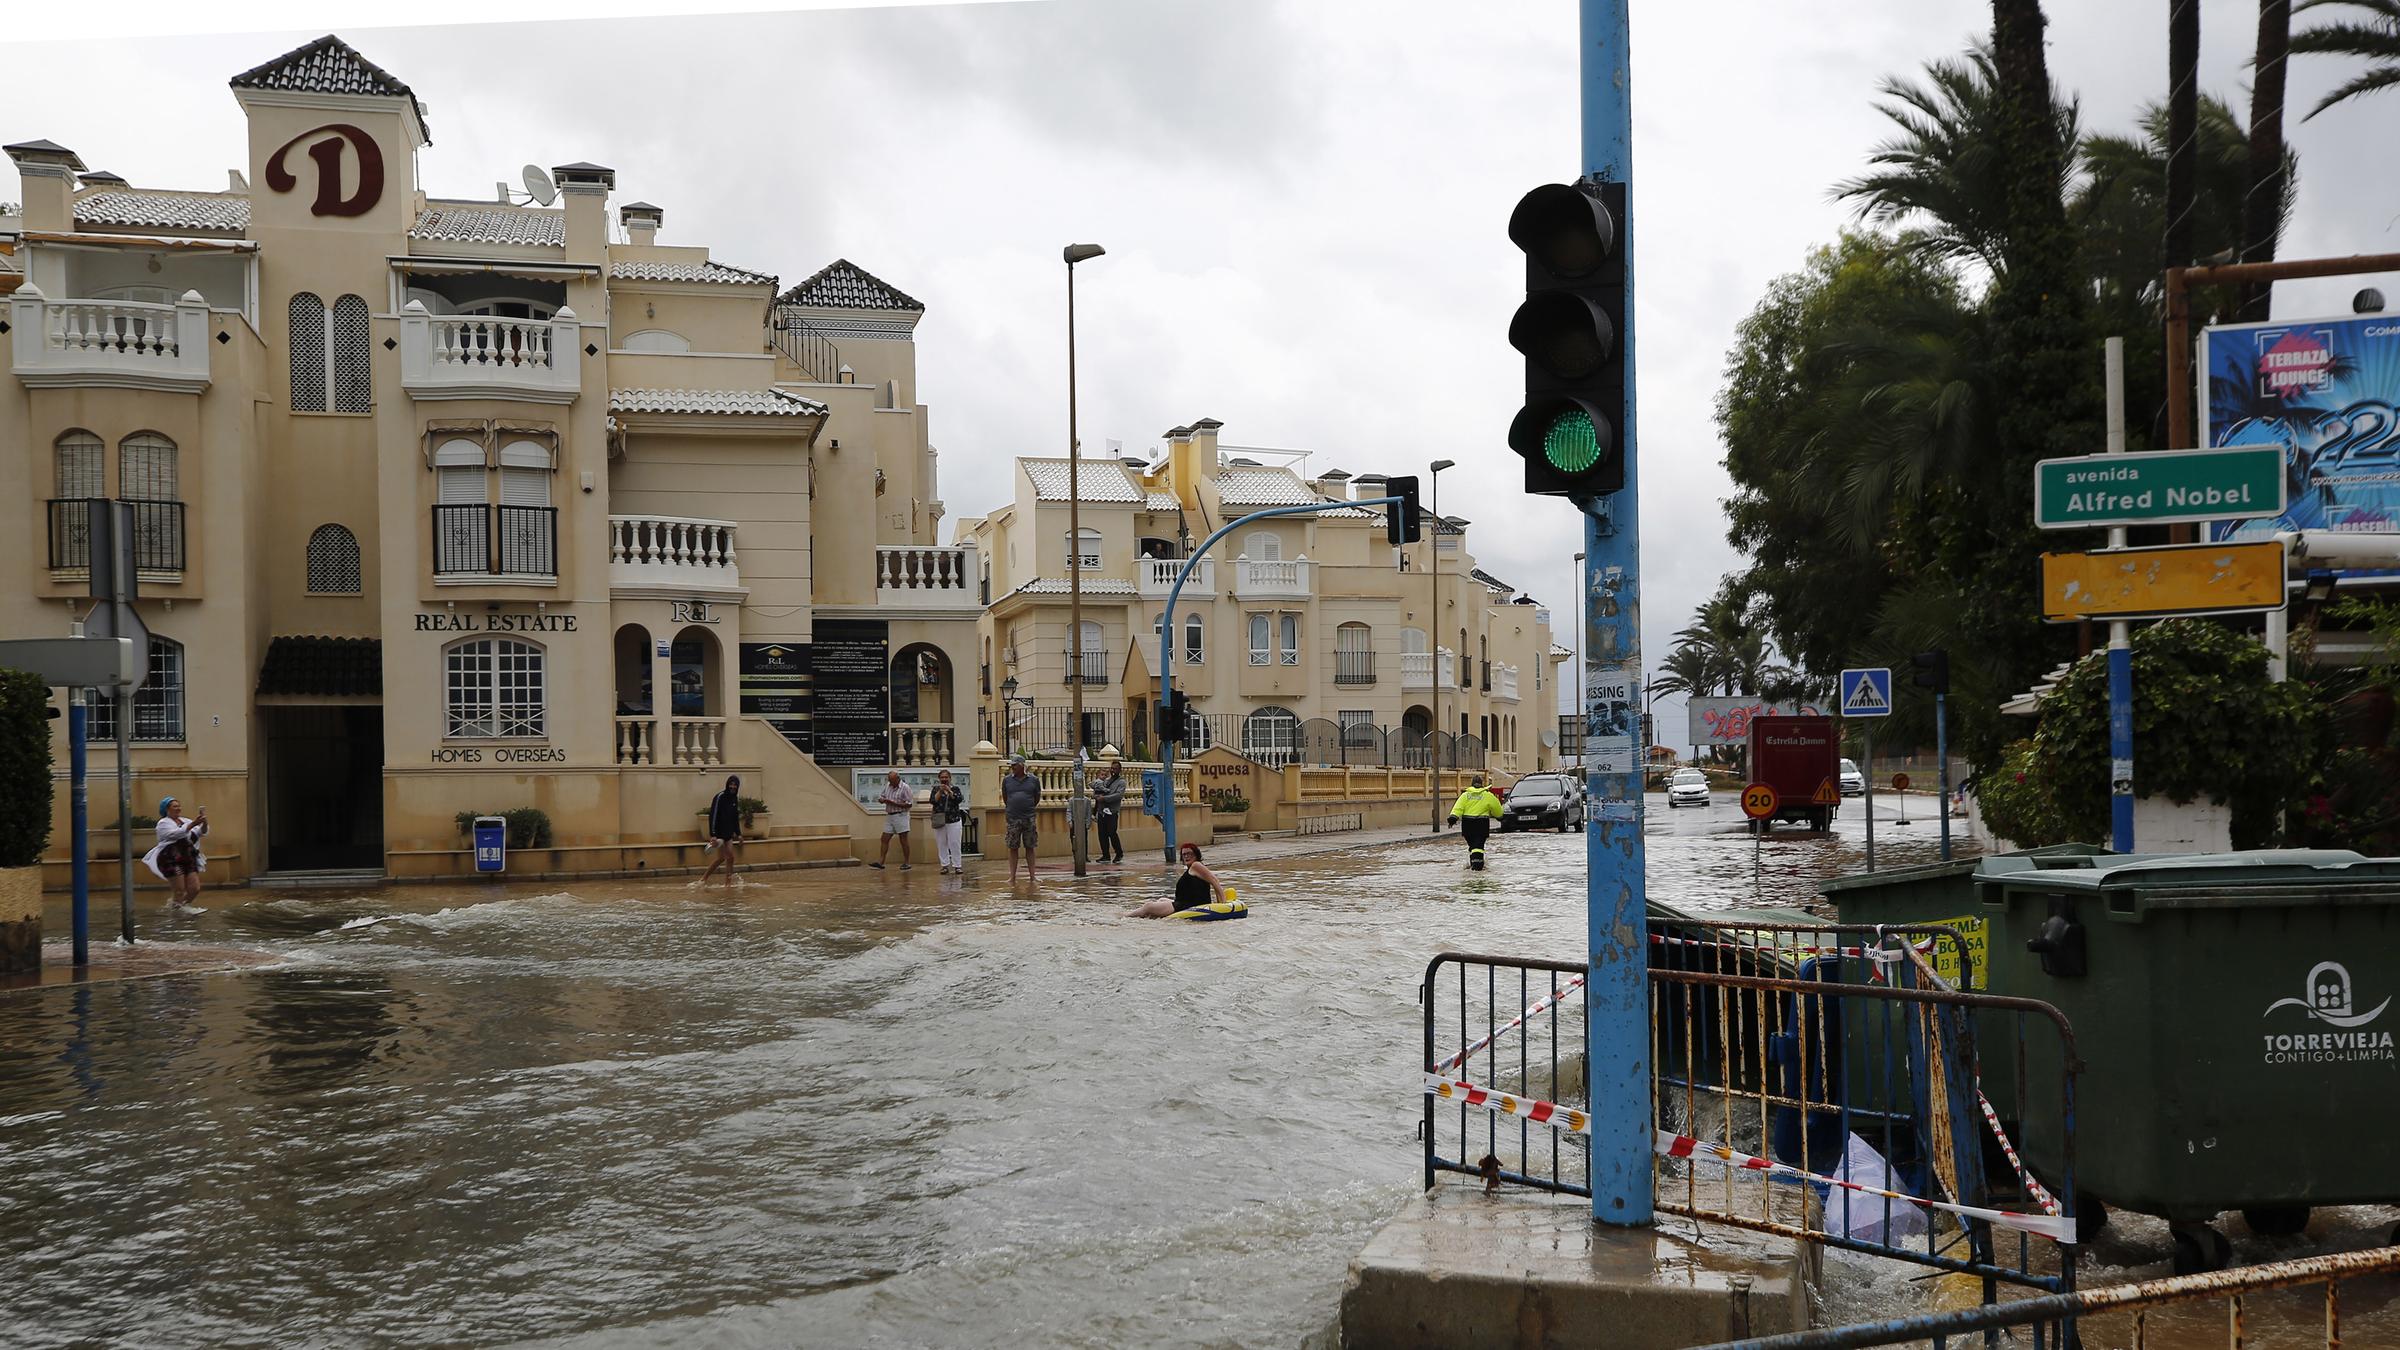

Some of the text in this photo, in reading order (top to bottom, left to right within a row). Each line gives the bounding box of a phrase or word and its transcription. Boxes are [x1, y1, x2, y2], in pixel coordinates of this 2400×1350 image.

[265, 123, 385, 217] D
[2266, 349, 2329, 368] TERRAZA
[2271, 369, 2326, 387] LOUNGE
[2066, 467, 2139, 484] avenida
[2066, 483, 2251, 513] Alfred Nobel
[671, 601, 721, 624] R&L
[414, 613, 578, 633] REAL ESTATE
[1765, 736, 1826, 746] Estrella Damm
[431, 748, 566, 763] HOMES OVERSEAS
[1597, 764, 1612, 772] 062
[1200, 784, 1241, 799] Beach
[1748, 794, 1771, 807] 20
[1939, 937, 1985, 954] BOSA
[1940, 955, 1982, 970] 23 HAS
[2263, 1031, 2394, 1050] TORREVIEJA
[2264, 1049, 2396, 1064] CONTIGO+LIMPIA
